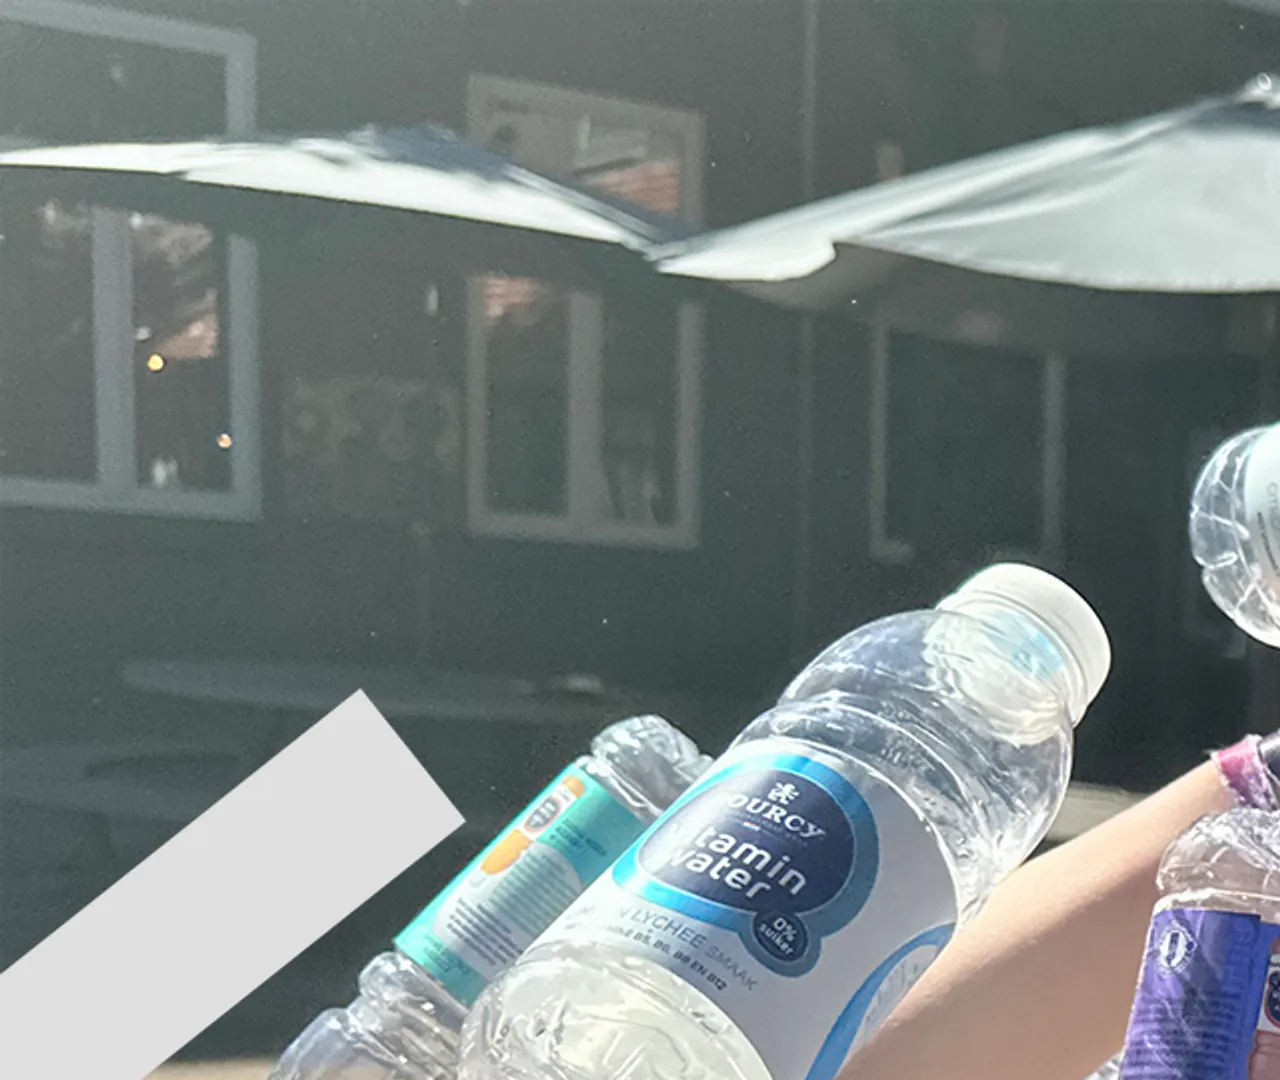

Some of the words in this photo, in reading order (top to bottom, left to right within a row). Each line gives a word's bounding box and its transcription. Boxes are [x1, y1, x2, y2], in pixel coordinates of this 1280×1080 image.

[721, 791, 827, 838] OURCY
[692, 825, 807, 896] tamin
[630, 906, 708, 950] LYCHEE
[704, 944, 760, 991] SMAAK
[758, 922, 795, 956] suiker
[772, 917, 797, 943] 0%
